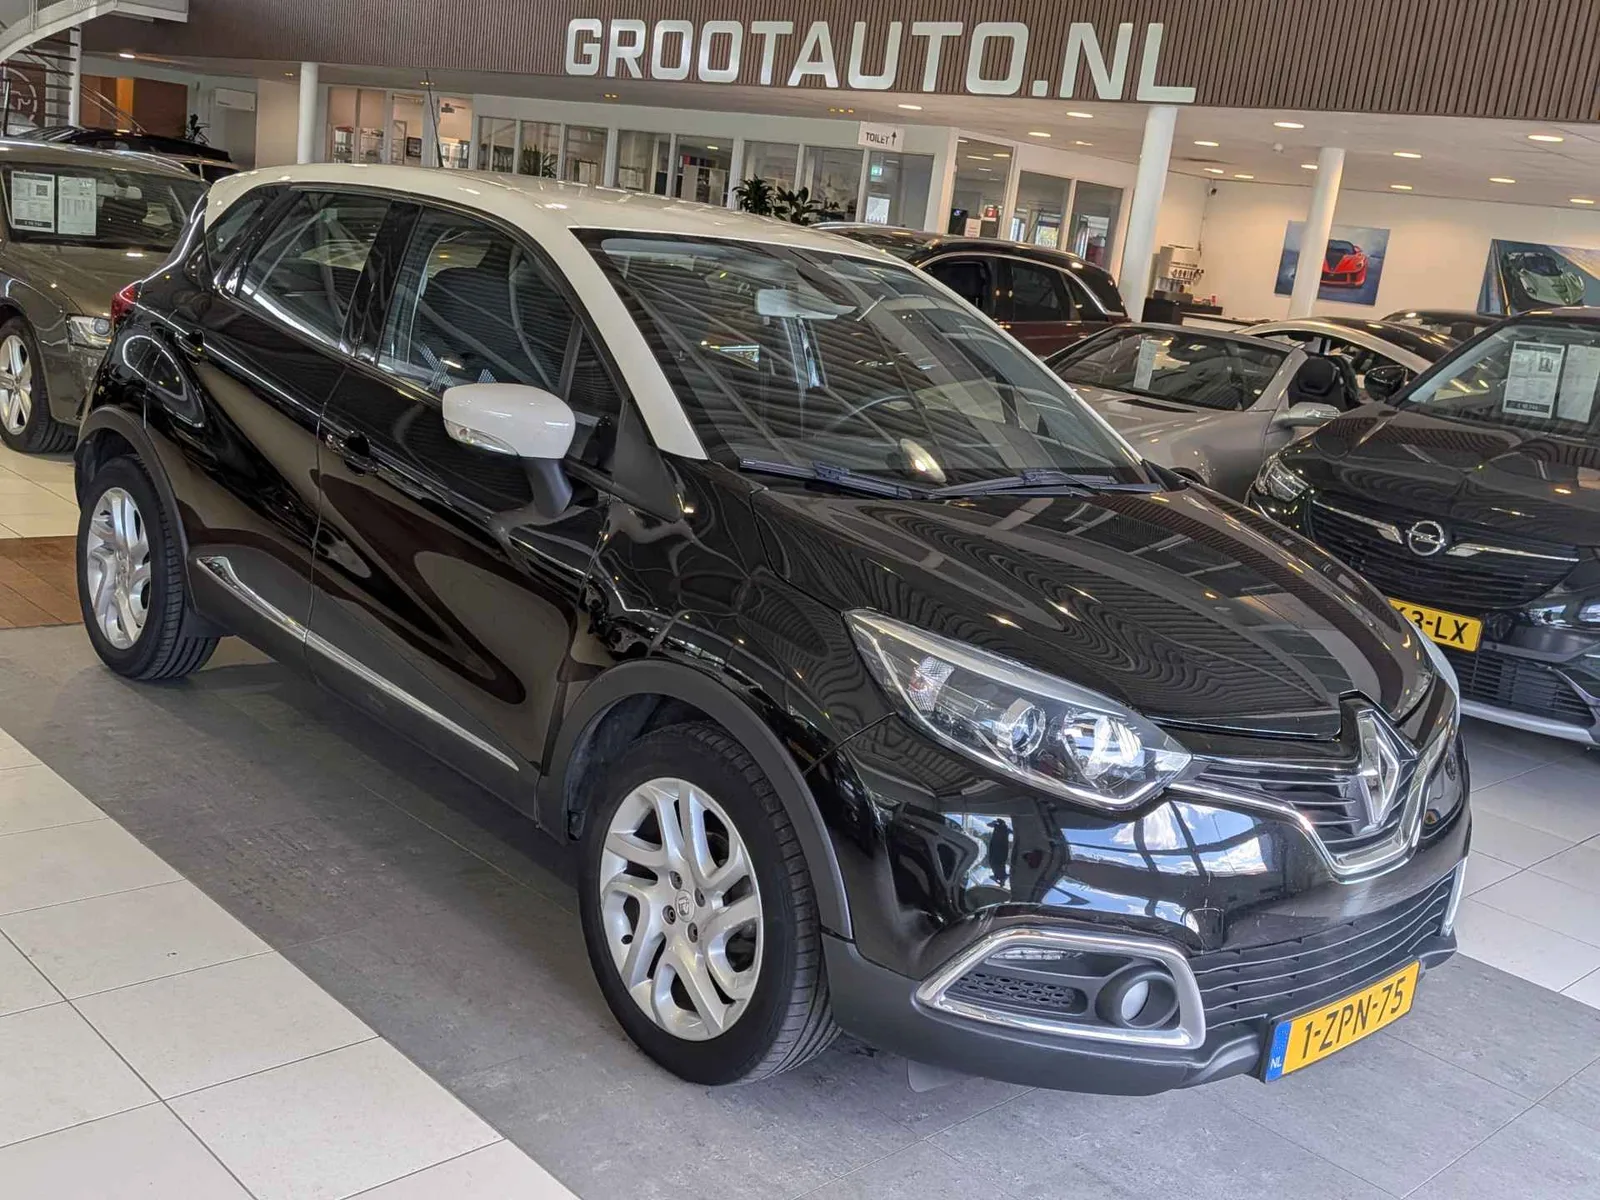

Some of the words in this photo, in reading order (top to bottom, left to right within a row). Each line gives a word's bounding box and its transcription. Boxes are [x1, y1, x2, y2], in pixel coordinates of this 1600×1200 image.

[565, 18, 1196, 103] GROOTAUTO.NL
[866, 131, 890, 145] TOILET
[1398, 607, 1469, 644] 3-LX
[1302, 975, 1406, 1060] 1-ZPN-75
[1270, 1056, 1282, 1069] NL
